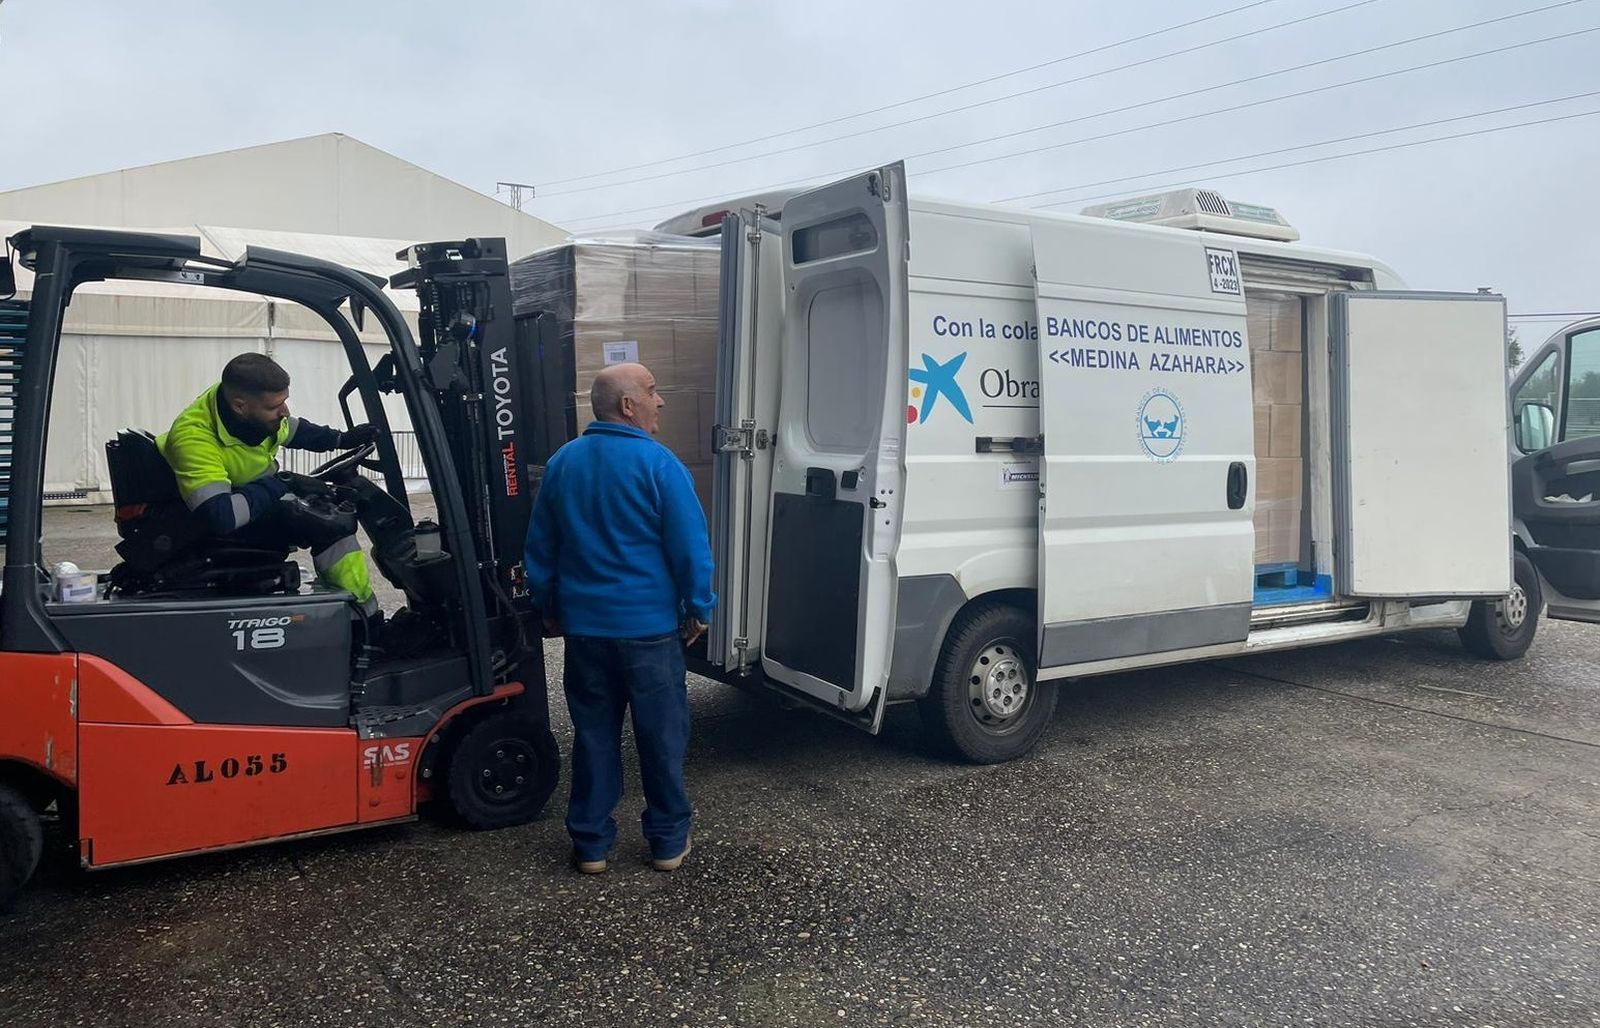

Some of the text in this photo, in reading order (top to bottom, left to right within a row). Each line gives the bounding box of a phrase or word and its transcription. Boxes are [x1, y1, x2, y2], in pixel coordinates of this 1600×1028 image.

[1208, 254, 1236, 277] FRCX
[933, 315, 1039, 341] Con la cola
[1046, 316, 1243, 348] BANCOS DE ALIMENTOS
[1049, 347, 1245, 375] <<MEDINA AZAHARA>>
[979, 368, 1041, 399] Obra
[490, 346, 519, 497] RENTAL TOYOTA
[227, 616, 292, 630] TRAIGO
[232, 627, 286, 651] 18
[364, 743, 410, 764] SAS
